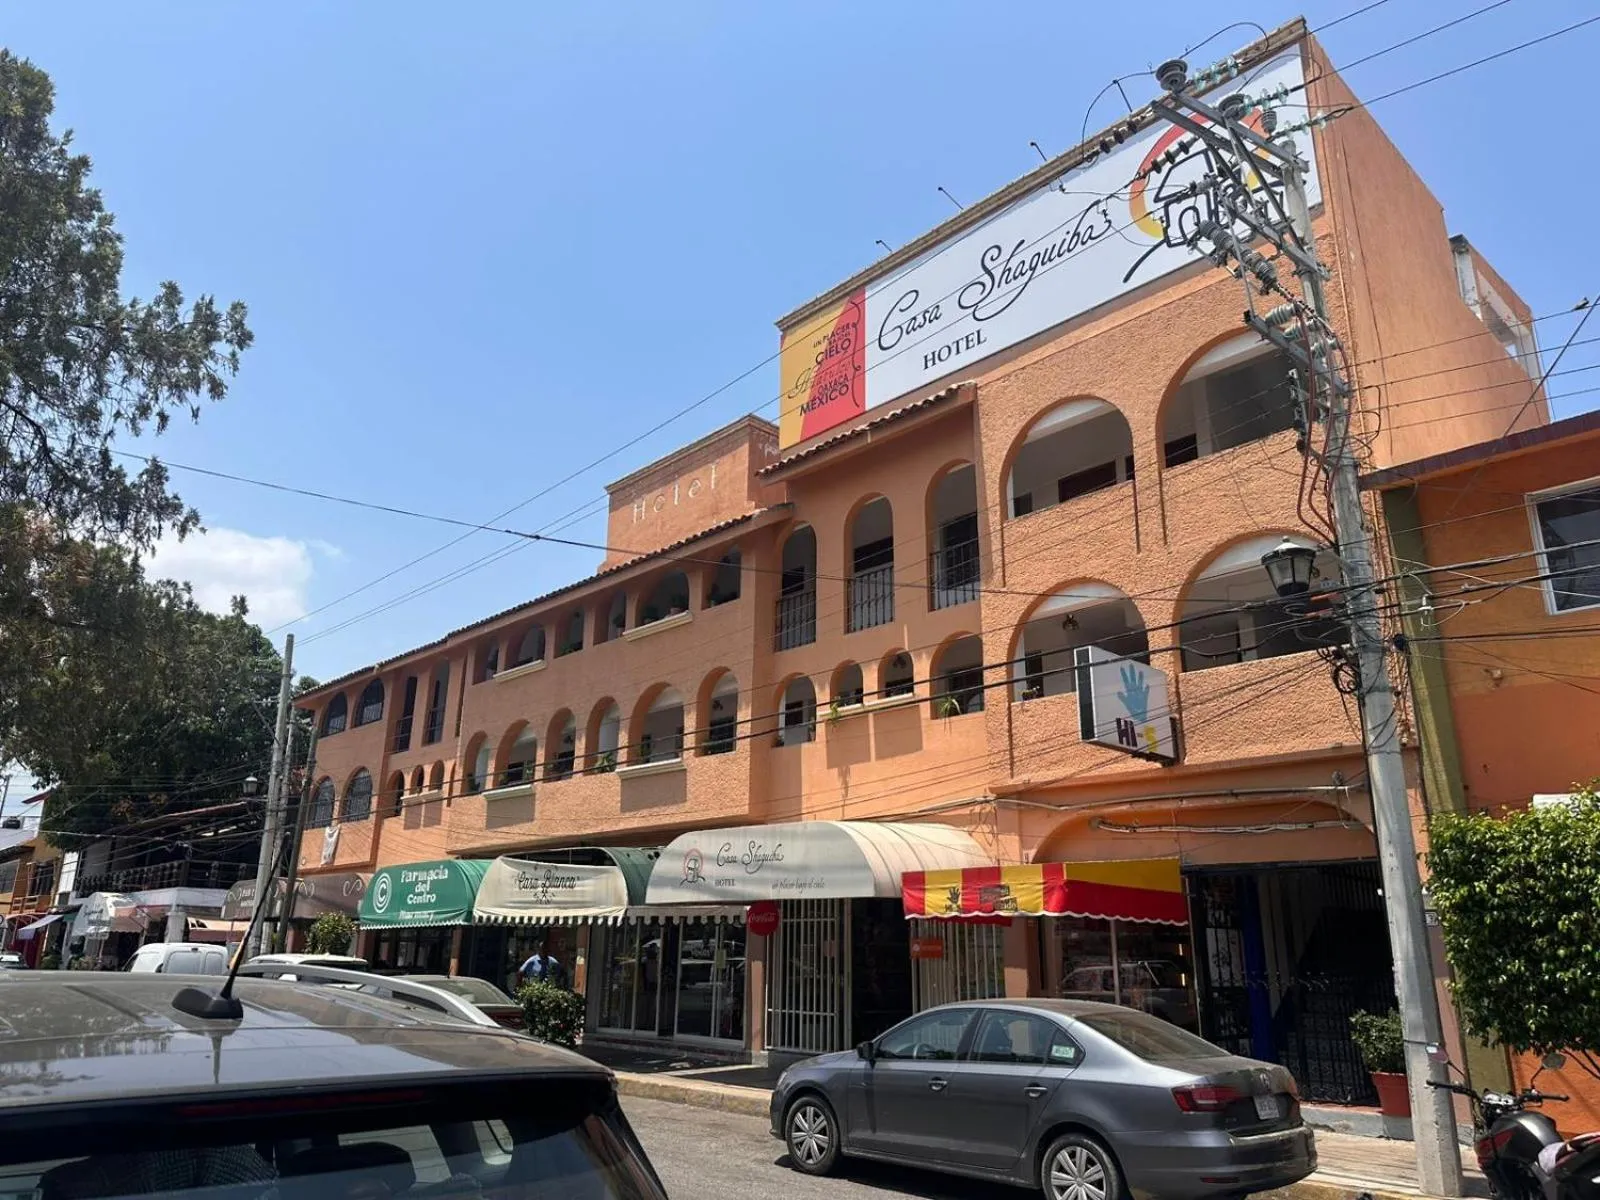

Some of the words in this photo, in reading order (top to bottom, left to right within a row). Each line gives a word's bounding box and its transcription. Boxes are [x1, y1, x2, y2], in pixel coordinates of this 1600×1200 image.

[878, 289, 942, 351] Casa
[815, 337, 852, 365] CIELO
[922, 329, 987, 371] HOTEL
